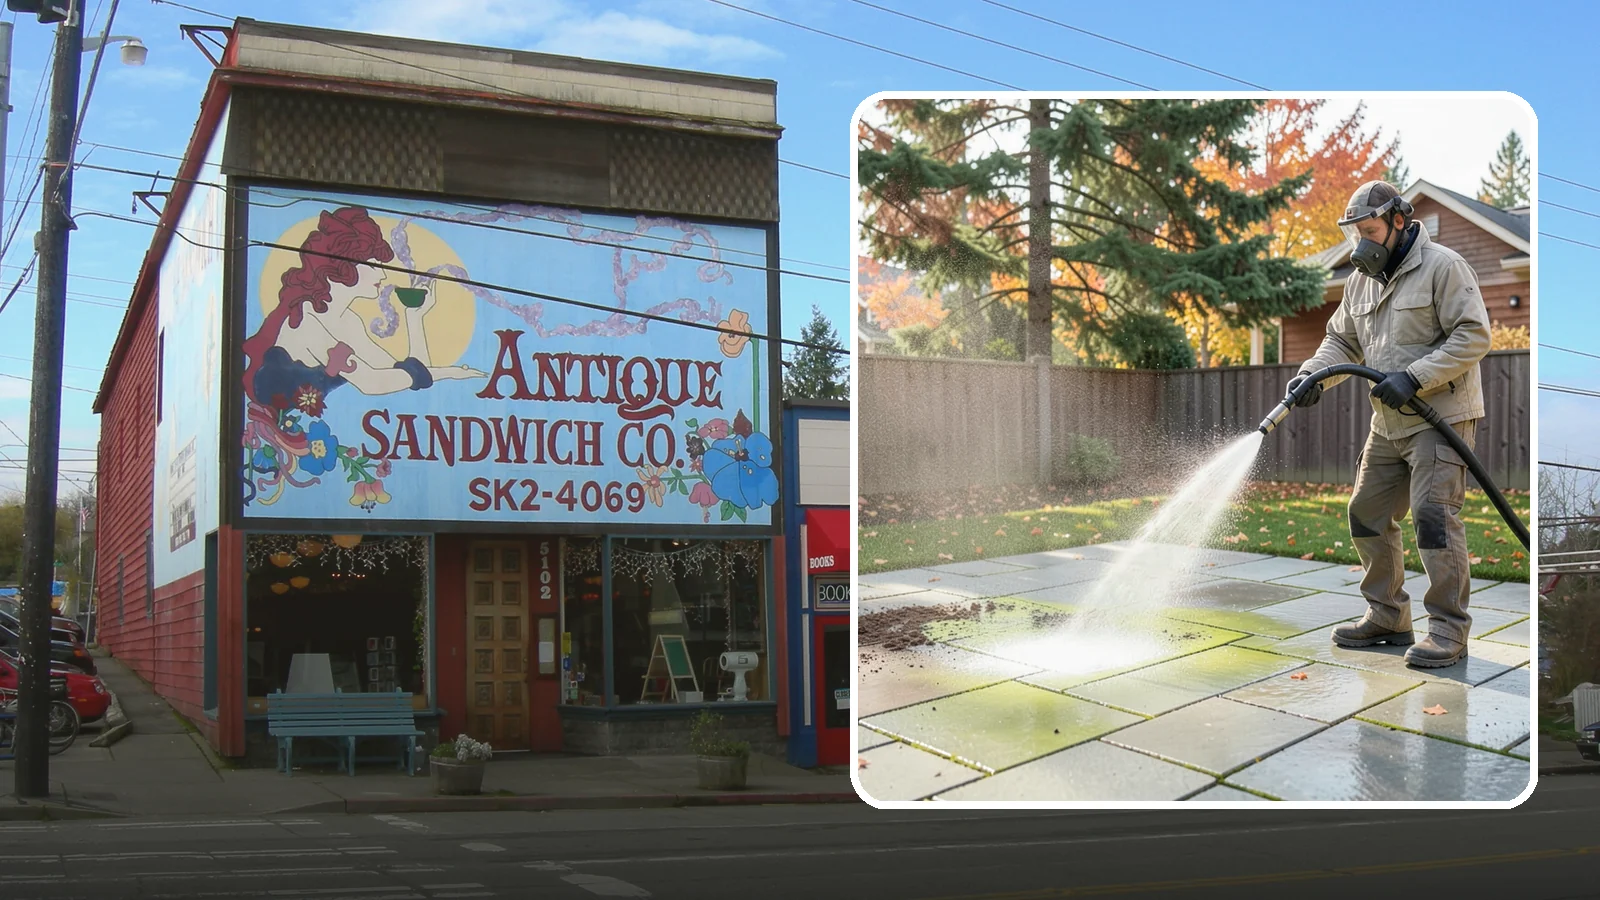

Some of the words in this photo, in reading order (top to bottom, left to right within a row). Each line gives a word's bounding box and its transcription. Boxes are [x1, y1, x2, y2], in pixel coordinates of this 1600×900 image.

[475, 329, 724, 421] ANTIQUE
[361, 408, 605, 468] SANDWICH
[617, 422, 685, 469] CO.
[468, 477, 646, 513] SK2-4069
[540, 542, 551, 599] 5102
[809, 555, 835, 569] BOOKS
